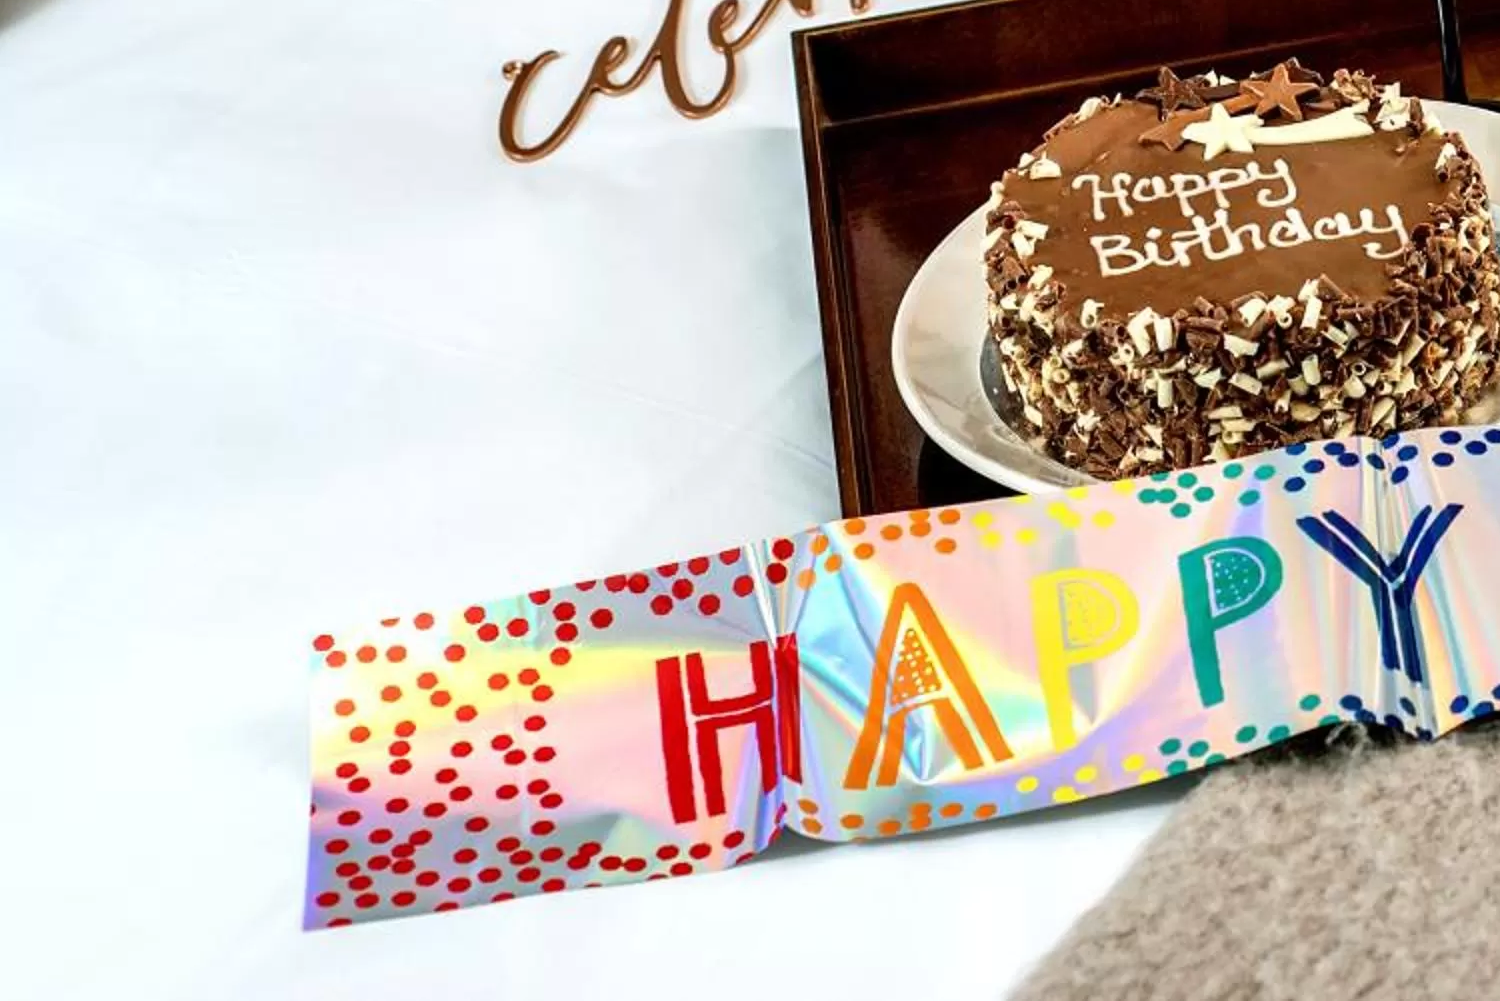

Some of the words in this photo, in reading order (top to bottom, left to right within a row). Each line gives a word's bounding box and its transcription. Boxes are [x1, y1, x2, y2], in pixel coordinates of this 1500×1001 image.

[1073, 159, 1298, 219] Happy
[1091, 205, 1408, 277] Birthday
[655, 502, 1464, 824] HAPPY
